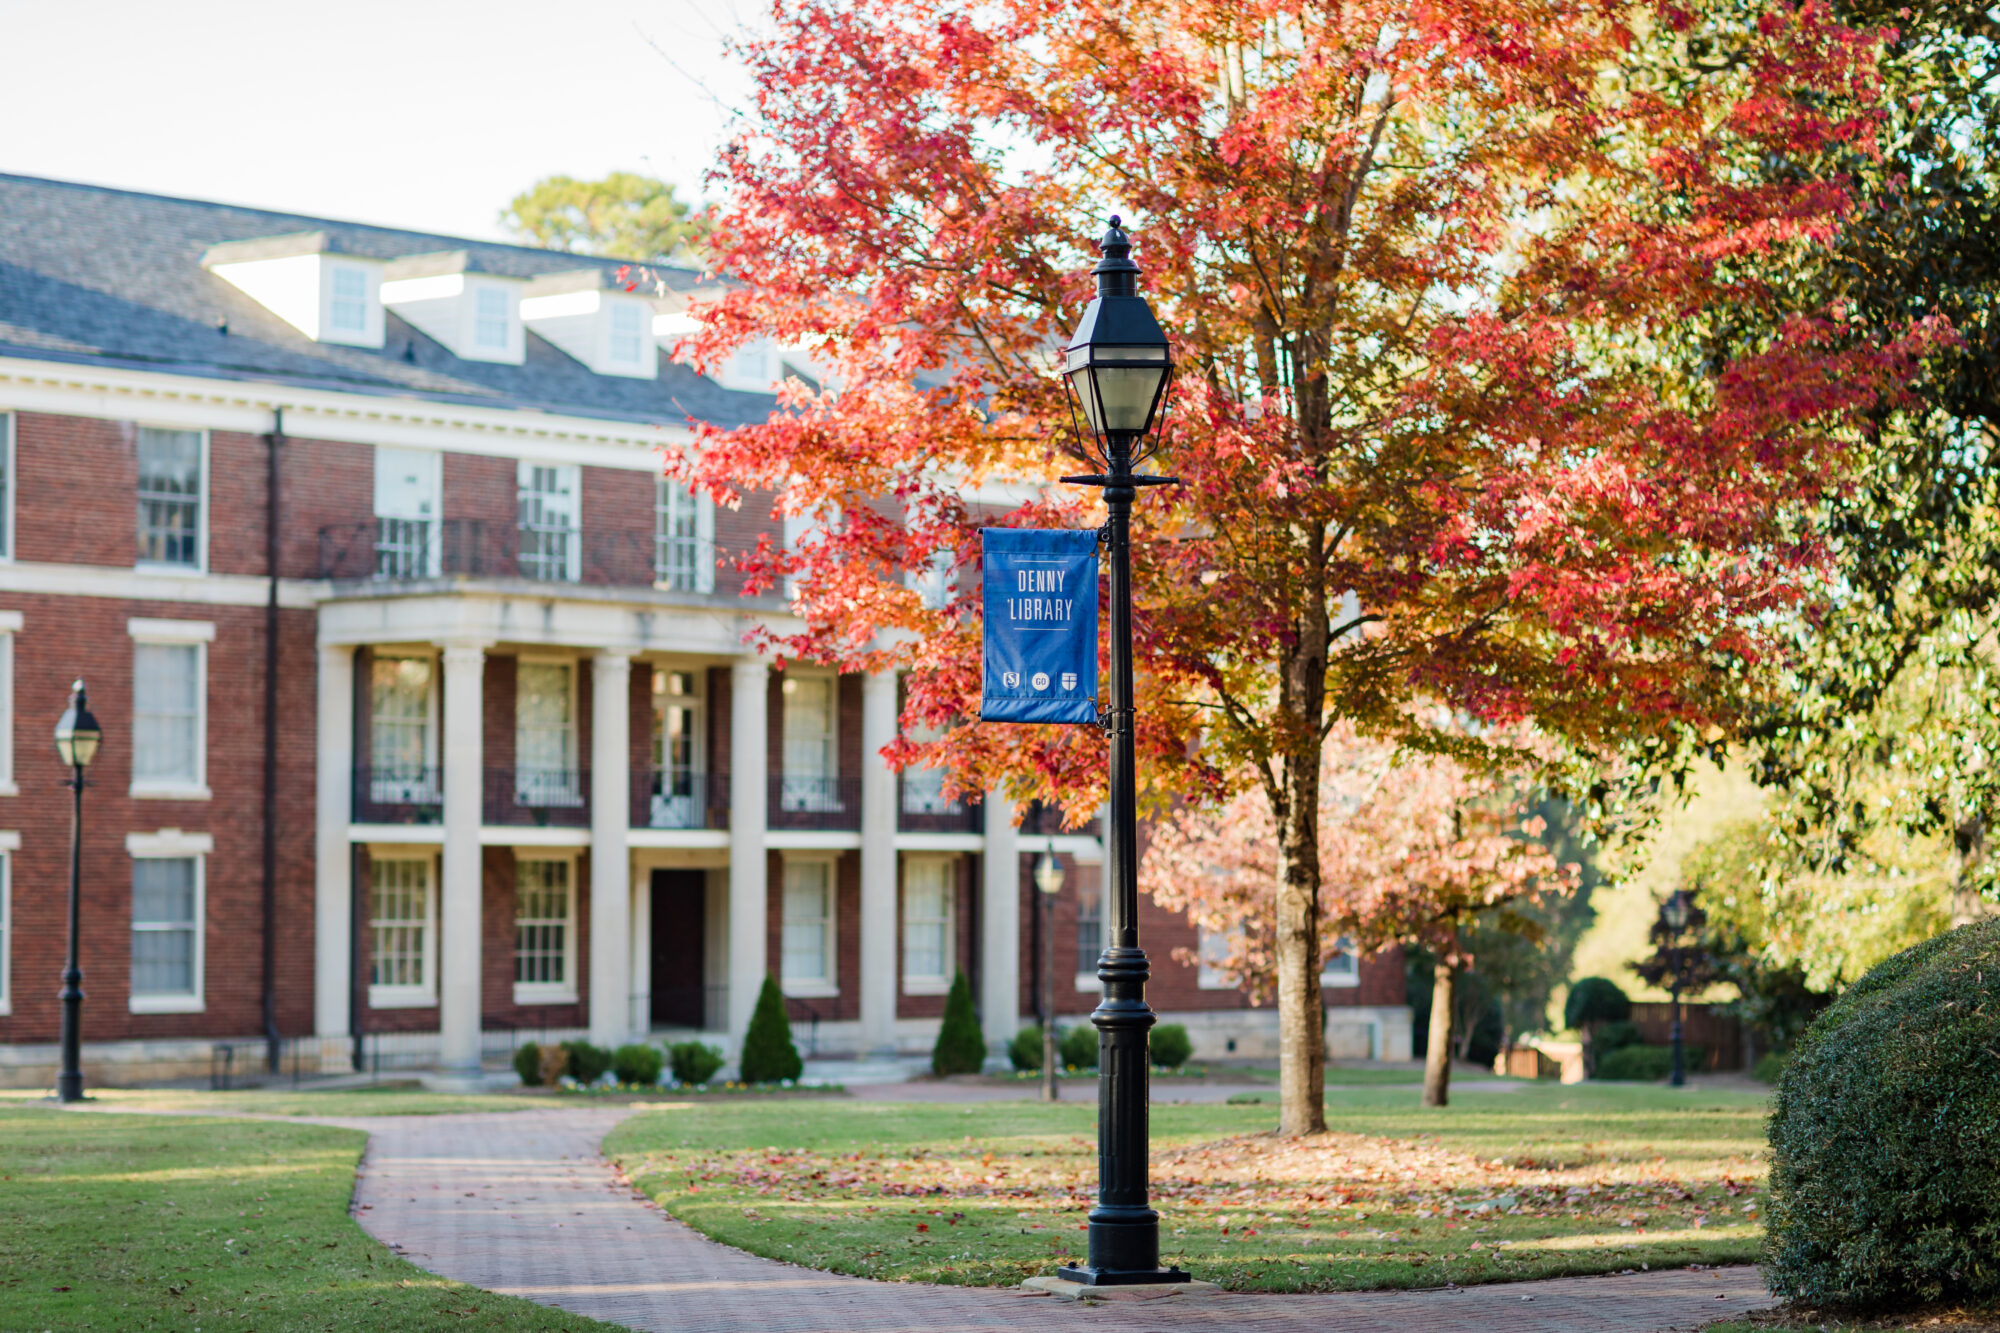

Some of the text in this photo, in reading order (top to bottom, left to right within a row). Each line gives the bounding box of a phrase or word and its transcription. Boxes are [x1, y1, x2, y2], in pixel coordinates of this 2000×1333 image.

[1018, 570, 1065, 592] DENNY
[1010, 598, 1072, 621] LIBRARY
[1035, 677, 1047, 686] GO
